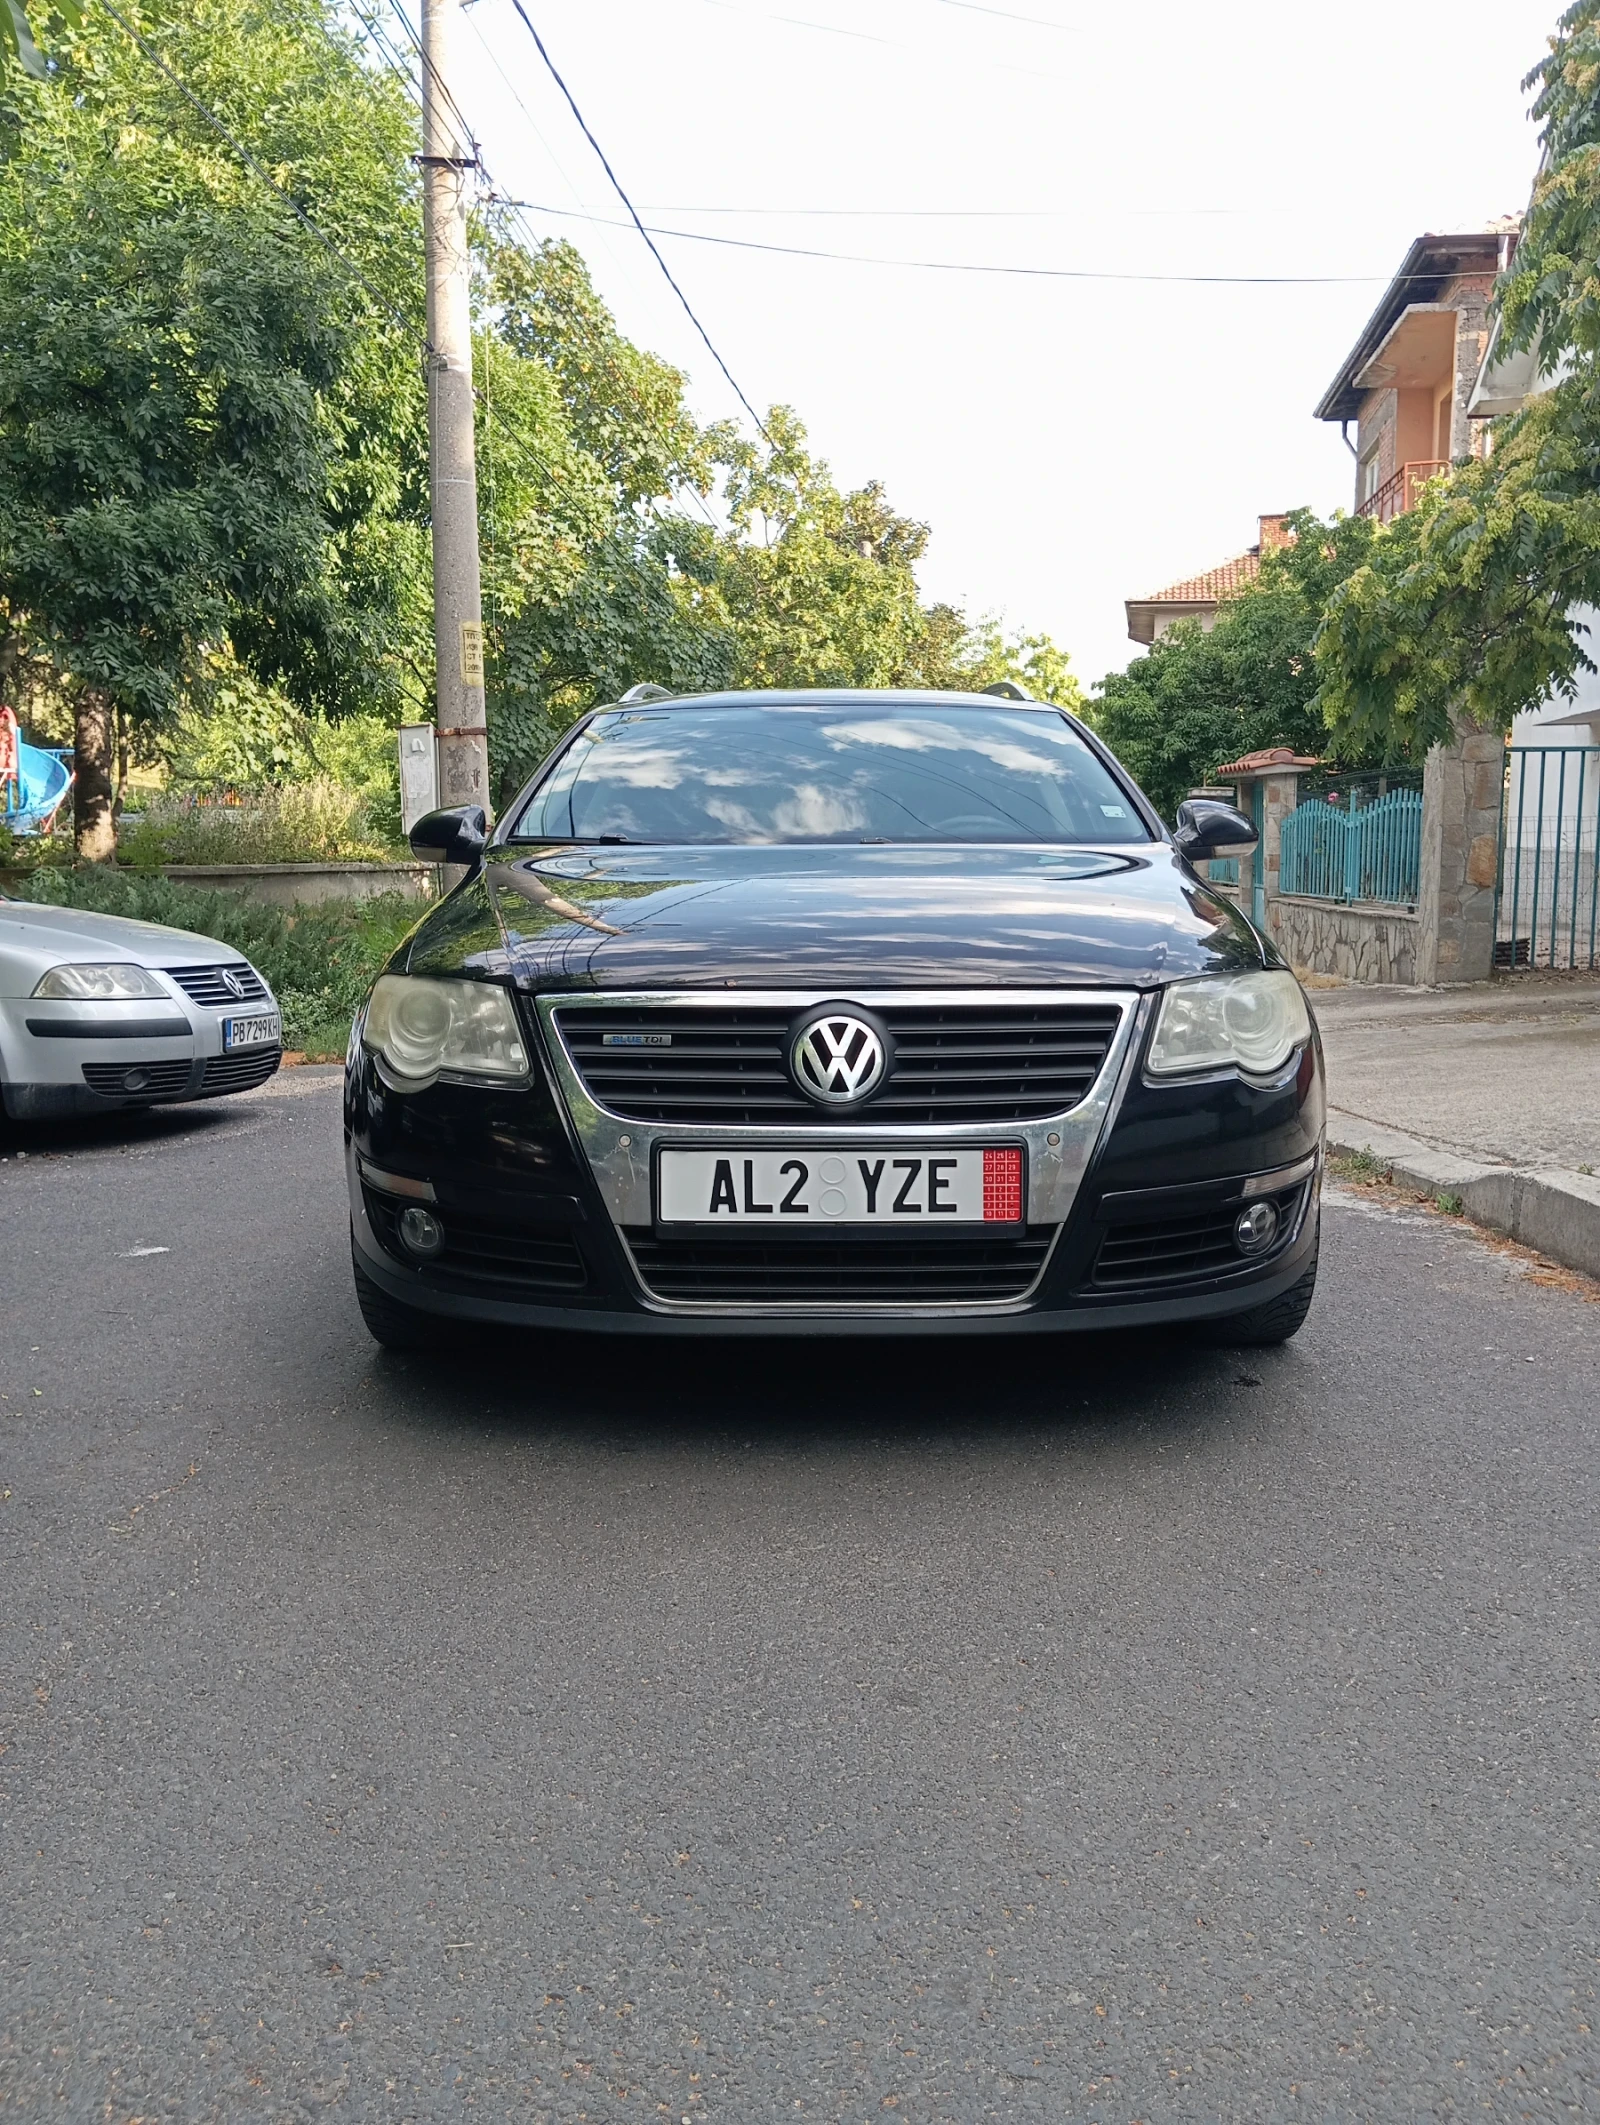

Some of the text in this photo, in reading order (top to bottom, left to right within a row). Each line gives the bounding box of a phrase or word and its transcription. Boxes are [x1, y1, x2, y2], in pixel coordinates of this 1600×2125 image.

[795, 1015, 882, 1102] VW
[709, 1158, 957, 1213] AL2 YZE
